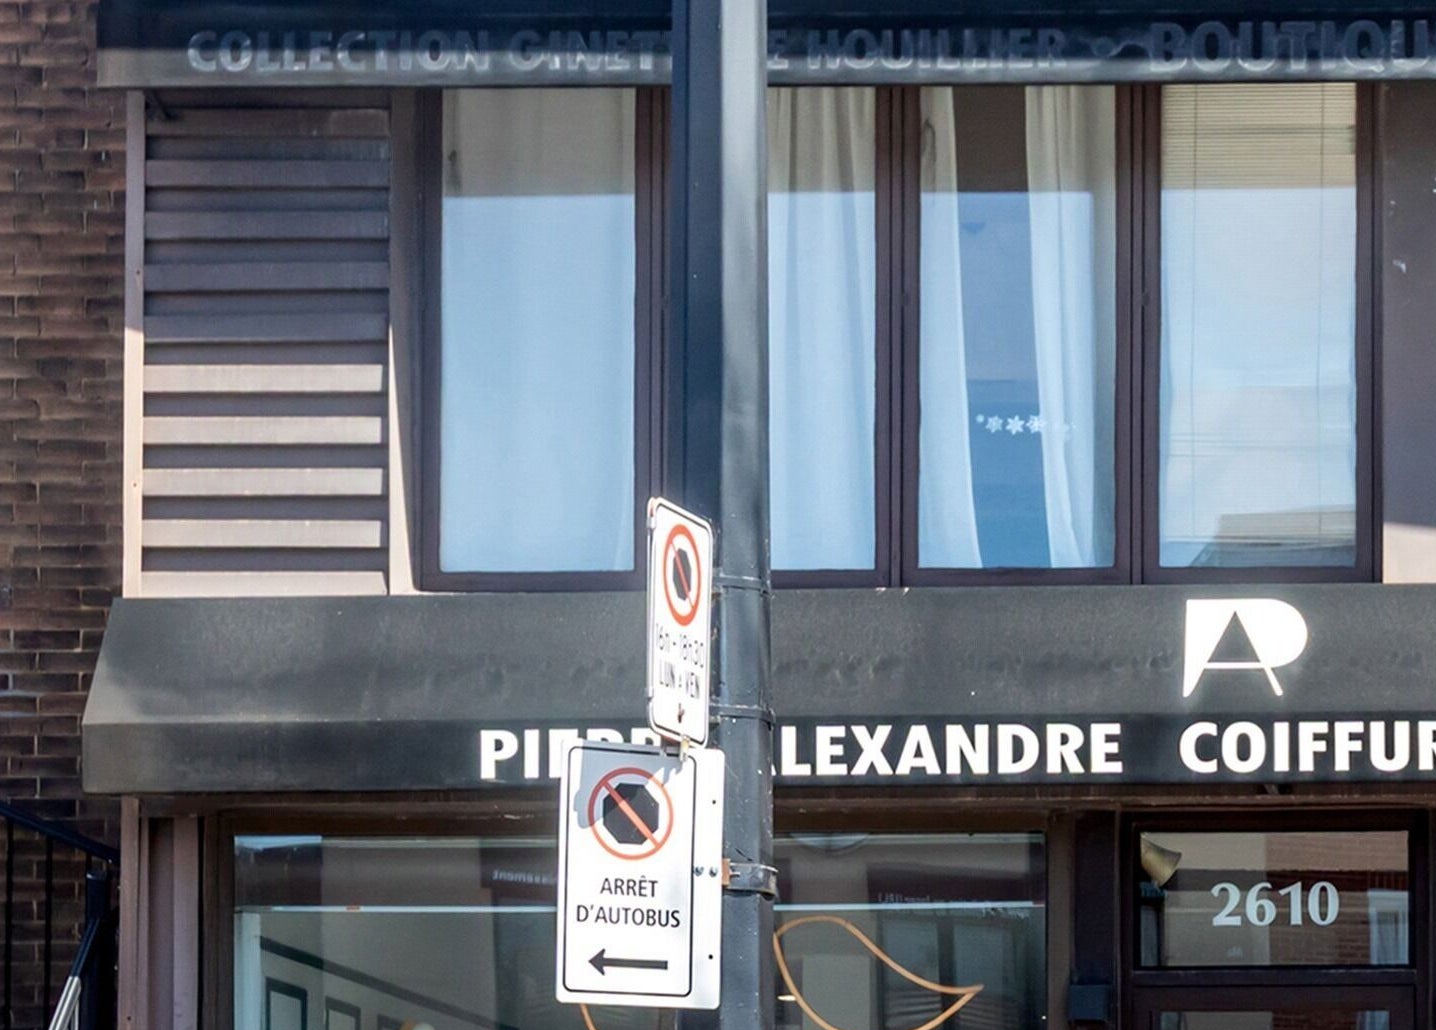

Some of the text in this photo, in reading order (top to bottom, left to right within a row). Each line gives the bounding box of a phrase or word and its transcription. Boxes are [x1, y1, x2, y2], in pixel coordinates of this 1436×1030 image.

[187, 29, 490, 73] COLLECTION
[507, 29, 672, 73] GINET
[771, 723, 1122, 775] LEXANDRE
[600, 874, 659, 898] ARRÊT
[1210, 880, 1340, 927] 2610
[576, 904, 681, 929] D'AUTOBUS
